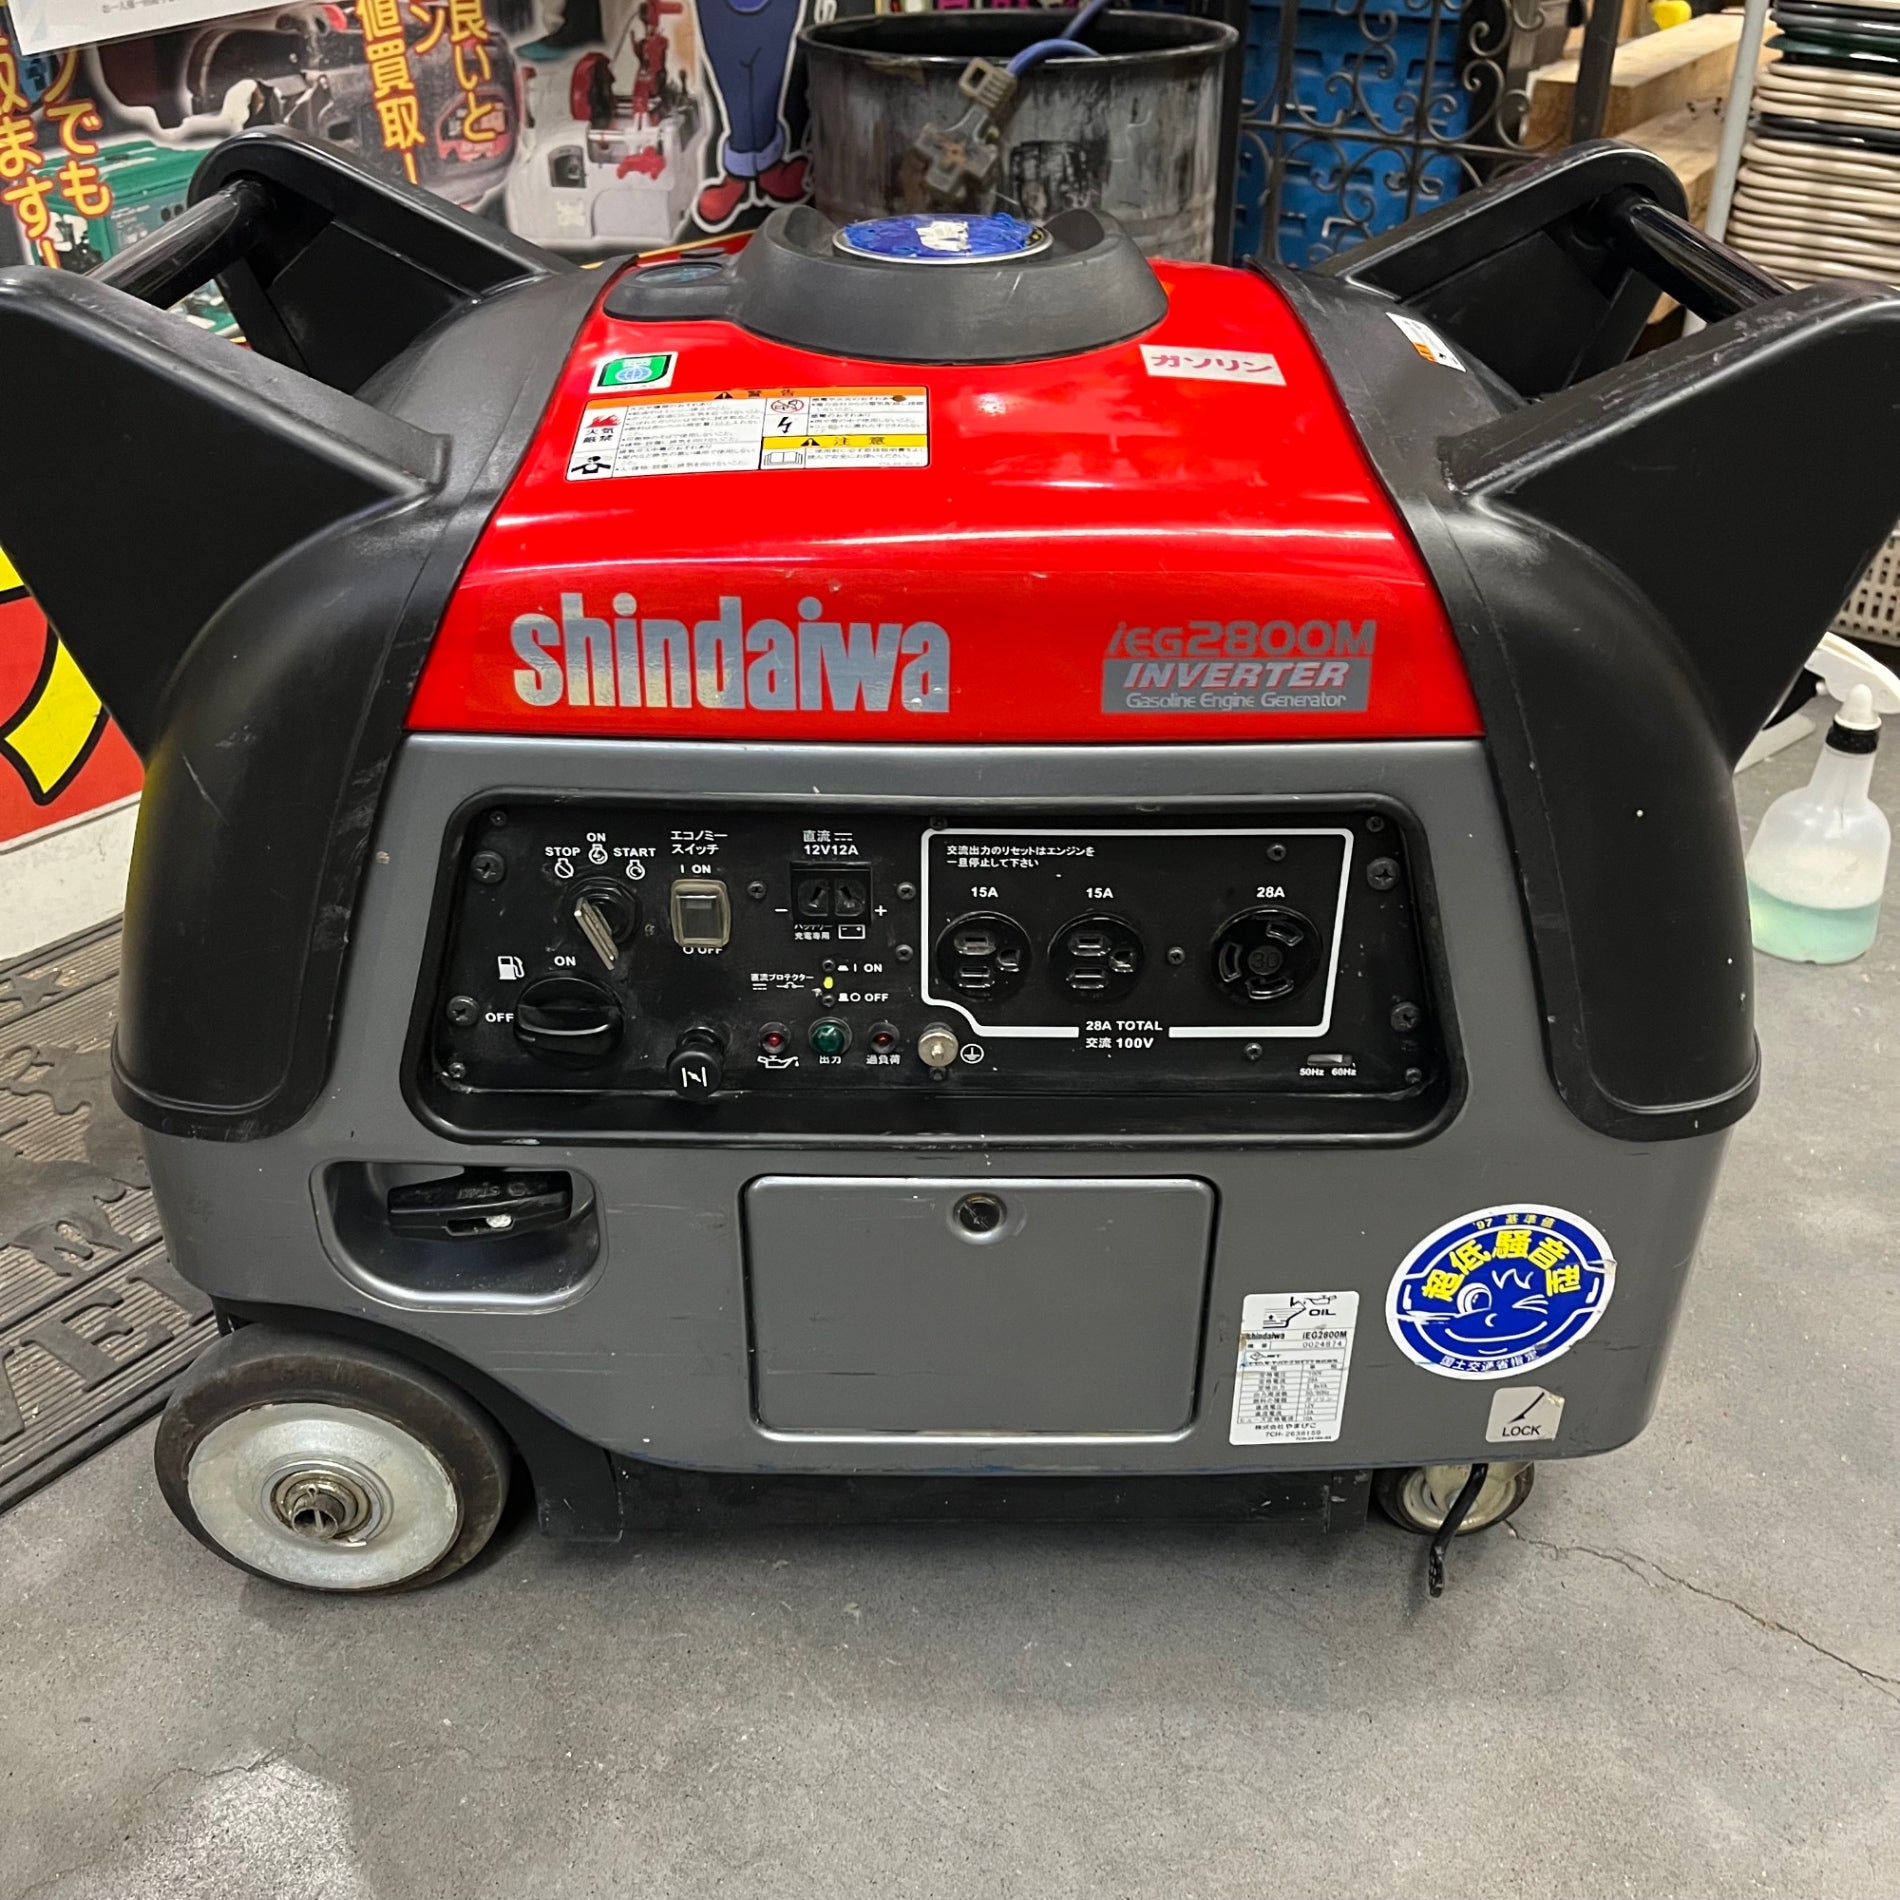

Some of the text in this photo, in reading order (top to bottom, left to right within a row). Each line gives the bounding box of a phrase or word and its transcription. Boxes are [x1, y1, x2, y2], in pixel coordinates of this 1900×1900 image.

[1151, 355, 1273, 373] ガソリン
[510, 592, 951, 713] shindaiwa
[1123, 661, 1350, 688] INVERTER
[1126, 692, 1347, 711] Gasoline Engine Generator
[586, 832, 607, 842] ON
[670, 830, 729, 841] エコノミー
[803, 830, 832, 842] 直流
[544, 846, 581, 857] STOP
[613, 847, 656, 857] START
[671, 843, 720, 855] スイッチ
[946, 857, 1039, 868] 一旦停止して下さい
[691, 864, 712, 874] ON
[970, 886, 999, 898] 15A
[1086, 887, 1114, 899] 15A
[1256, 886, 1285, 898] 28A
[553, 955, 577, 967] ON
[863, 963, 883, 973] ON
[864, 992, 889, 1002] OFF
[484, 1012, 515, 1023] OFF
[1085, 1020, 1164, 1031] 28A TOTAL
[1085, 1036, 1154, 1049] 交流 100V
[819, 1055, 842, 1065] 出力
[1299, 1067, 1357, 1077] 50Hz 60Hz
[1421, 1229, 1582, 1302] 超低騒音型
[1308, 1308, 1337, 1317] OIL
[1501, 1425, 1542, 1438] LOCK
